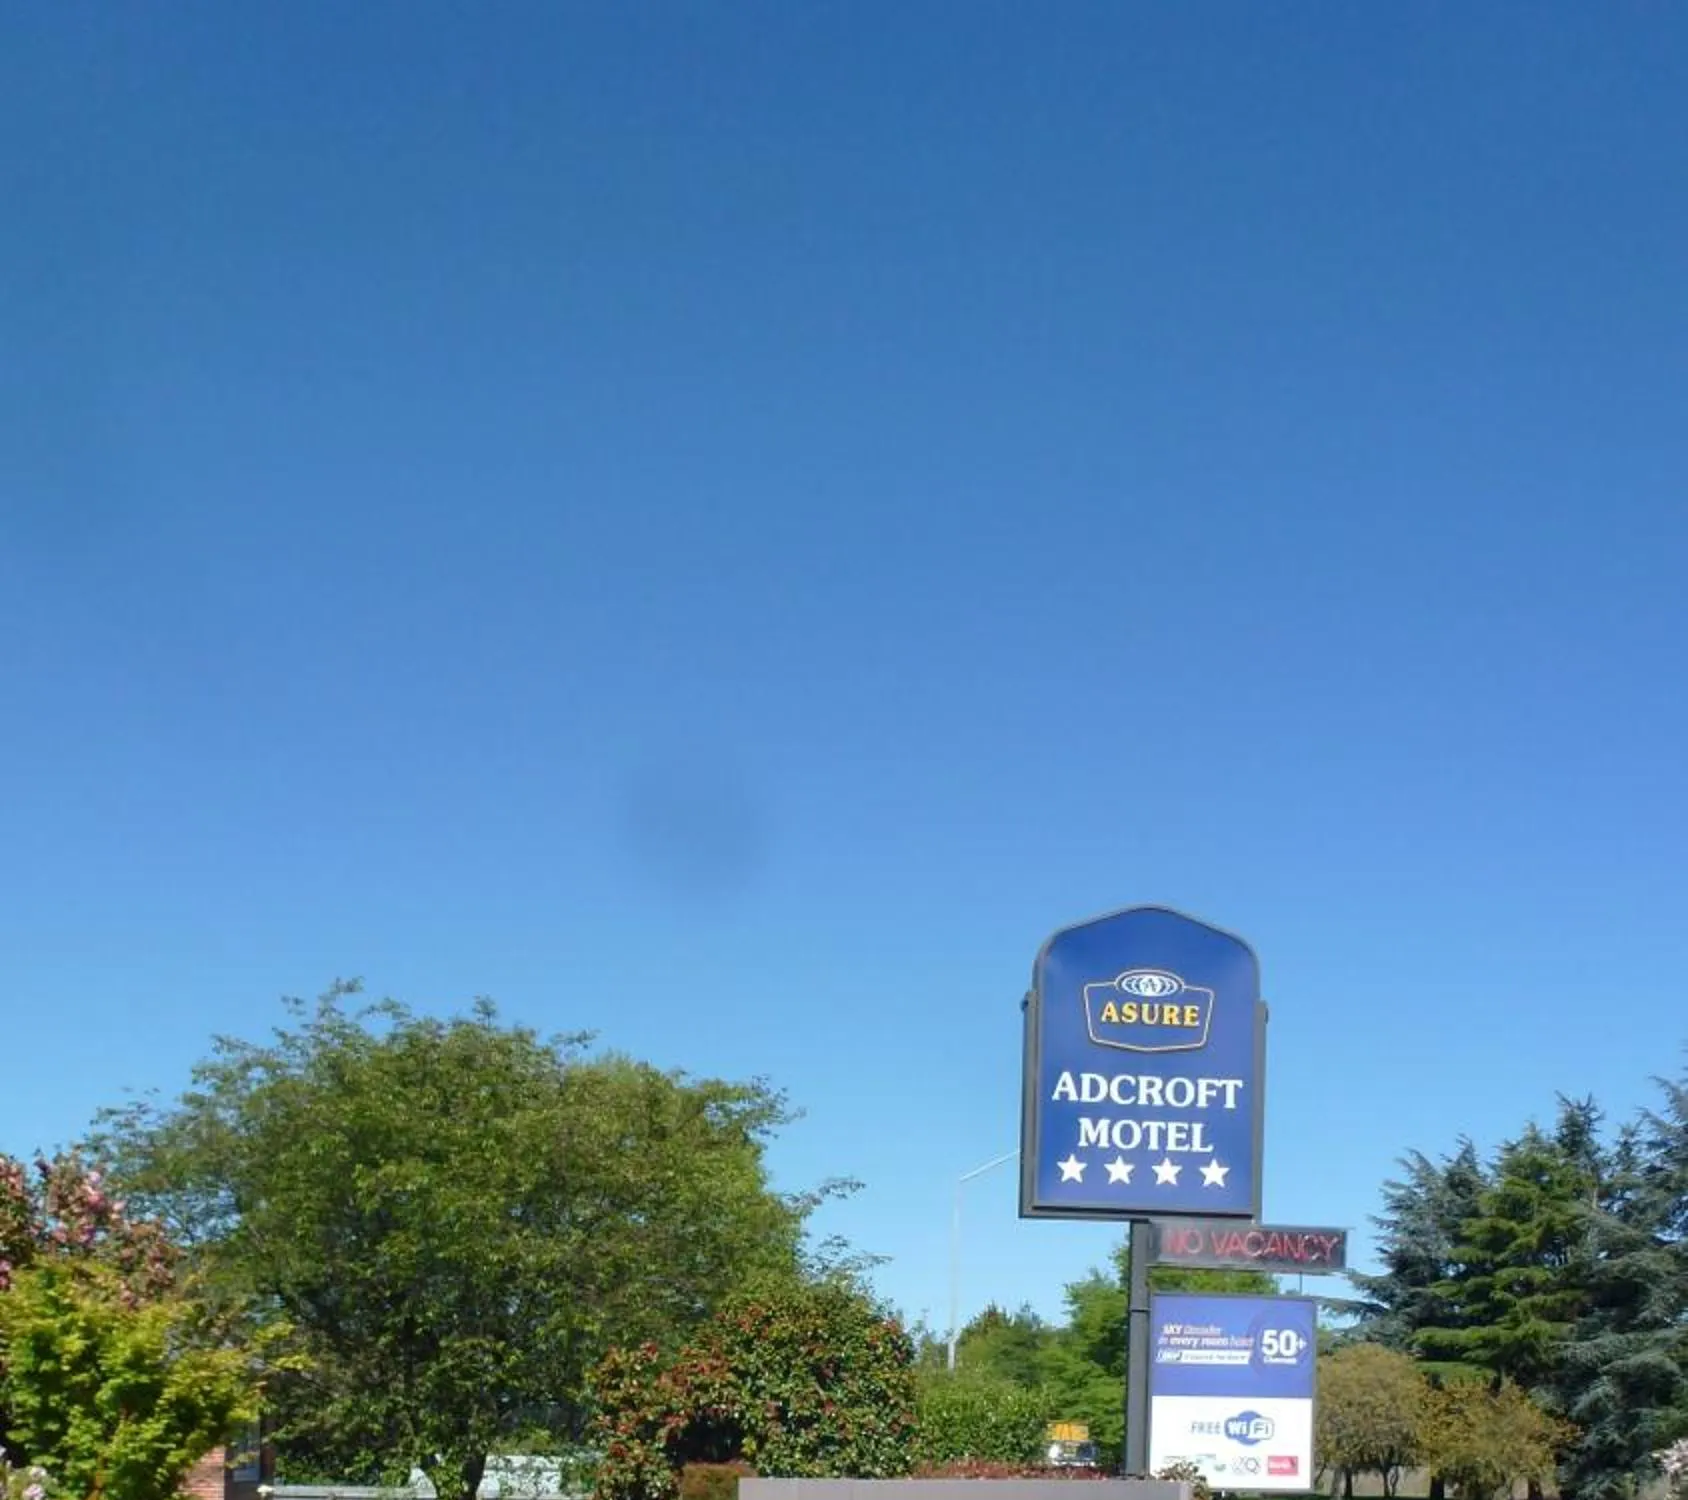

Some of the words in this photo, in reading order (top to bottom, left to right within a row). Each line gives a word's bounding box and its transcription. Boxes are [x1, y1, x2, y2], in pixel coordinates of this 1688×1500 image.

[1101, 1001, 1201, 1027] ASURE
[1051, 1071, 1243, 1110] ADCROFT
[1078, 1117, 1214, 1152] MOTEL
[1164, 1228, 1204, 1255] NO
[1210, 1230, 1341, 1263] VACANCY
[1261, 1328, 1307, 1357] 50+
[1190, 1421, 1221, 1434] FREE
